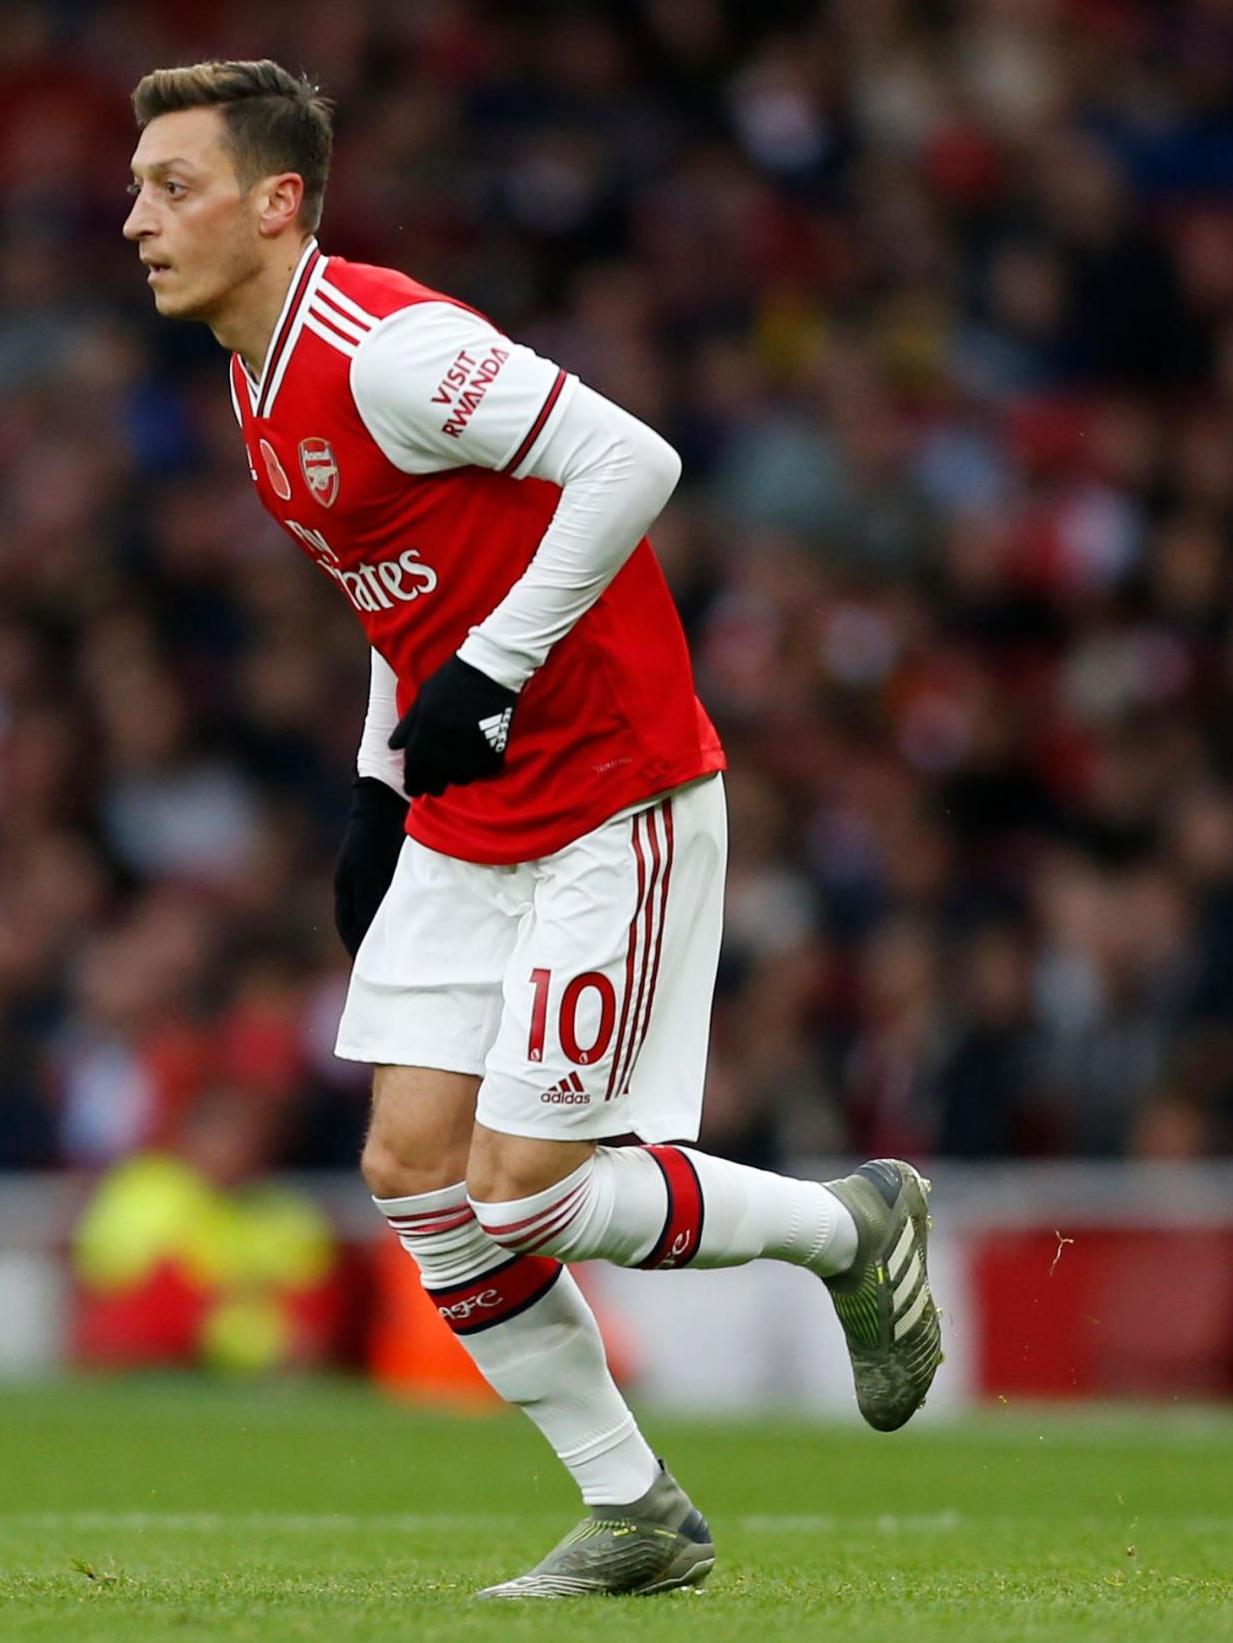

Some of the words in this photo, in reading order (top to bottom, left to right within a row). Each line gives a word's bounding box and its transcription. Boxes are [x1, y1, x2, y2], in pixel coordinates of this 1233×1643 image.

[431, 350, 476, 404] VISIT
[441, 347, 510, 438] RWANDA
[527, 967, 617, 1066] 10
[540, 1090, 591, 1105] adidas
